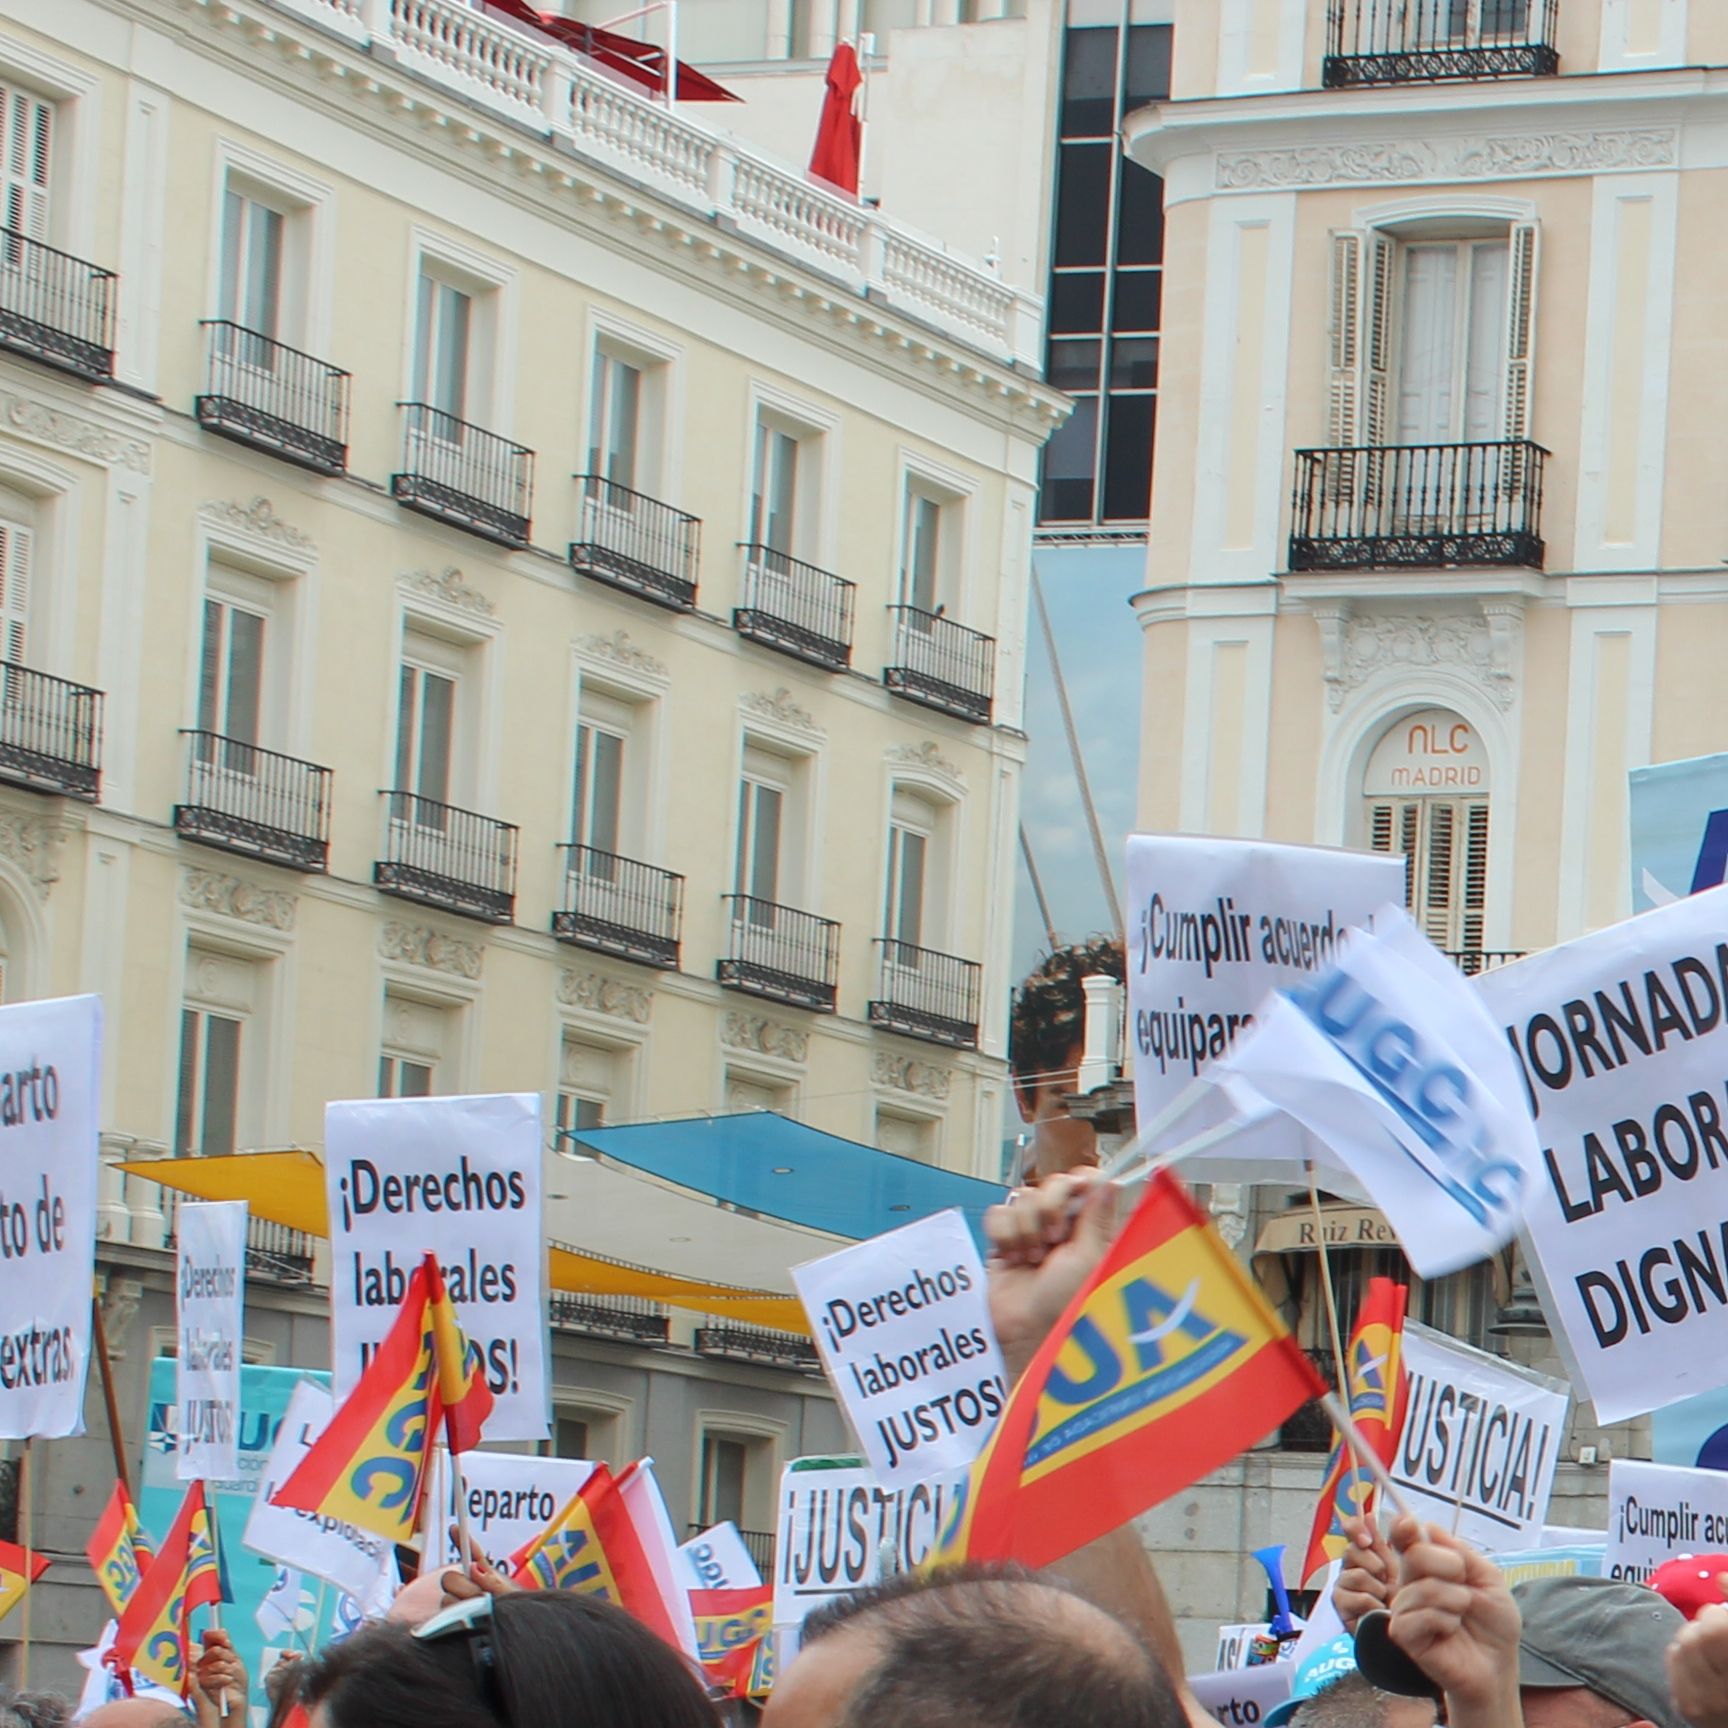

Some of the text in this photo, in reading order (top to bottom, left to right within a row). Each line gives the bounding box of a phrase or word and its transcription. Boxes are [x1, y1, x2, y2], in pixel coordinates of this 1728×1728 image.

[1139, 892, 1251, 979] ¡Cumplir
[37, 1174, 65, 1254] de
[340, 1155, 526, 1233] ¡Derechos
[354, 1247, 517, 1306] labales
[820, 1261, 972, 1355] ¡Derechos
[850, 1322, 989, 1402] laborales
[1402, 1370, 1550, 1521] USTICIA!
[1619, 1494, 1699, 1549] ¡Cumplir
[1304, 1656, 1356, 1683] AUG
